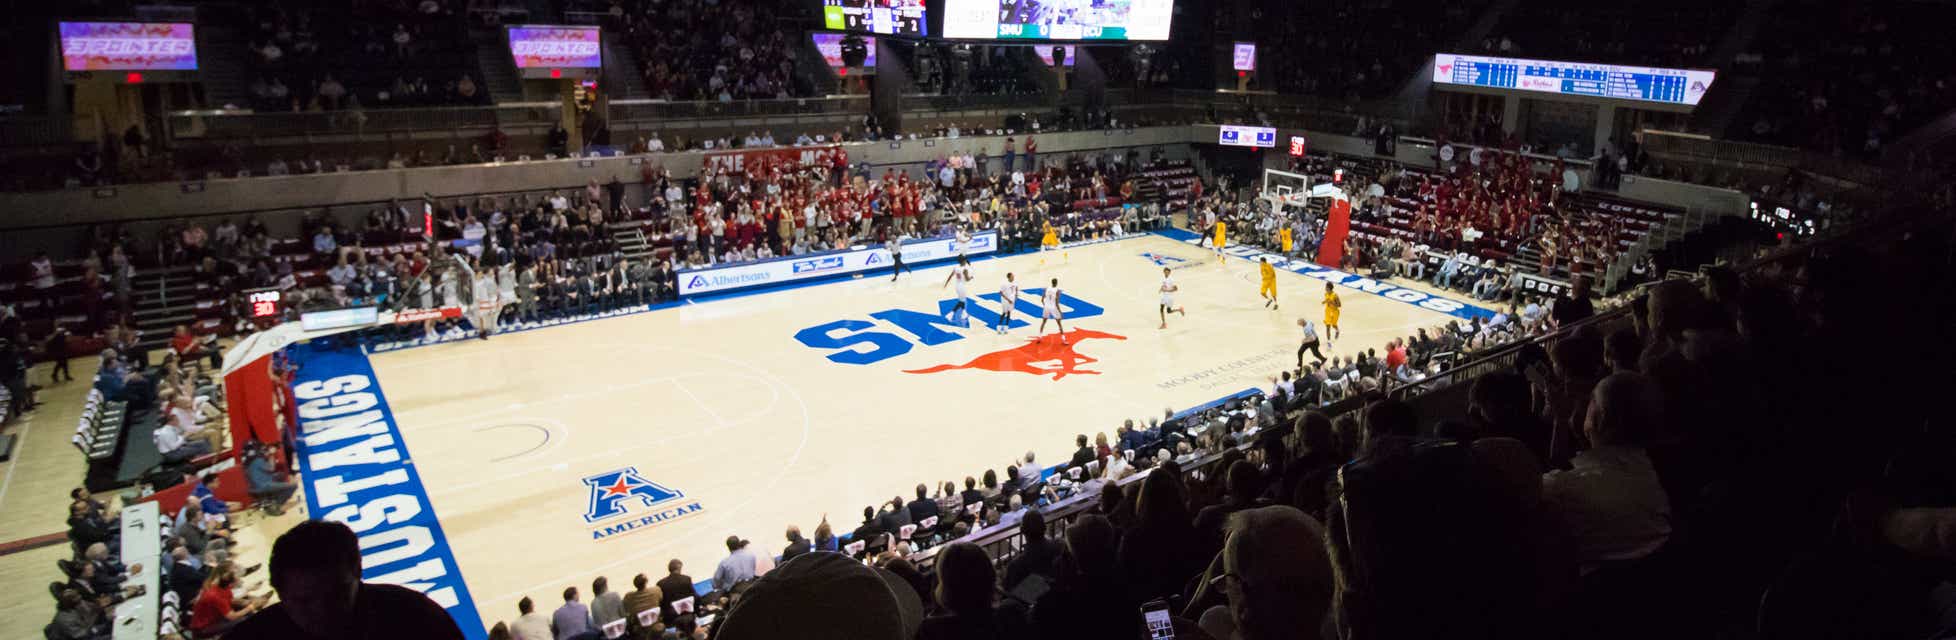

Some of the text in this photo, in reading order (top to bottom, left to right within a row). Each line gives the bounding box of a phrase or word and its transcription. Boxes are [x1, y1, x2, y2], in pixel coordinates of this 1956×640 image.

[999, 24, 1023, 36] SMU
[711, 154, 745, 174] THE
[711, 271, 771, 287] Albertsons
[255, 302, 275, 317] 30
[793, 288, 1104, 365] SMU
[593, 502, 703, 540] AMERICAN
